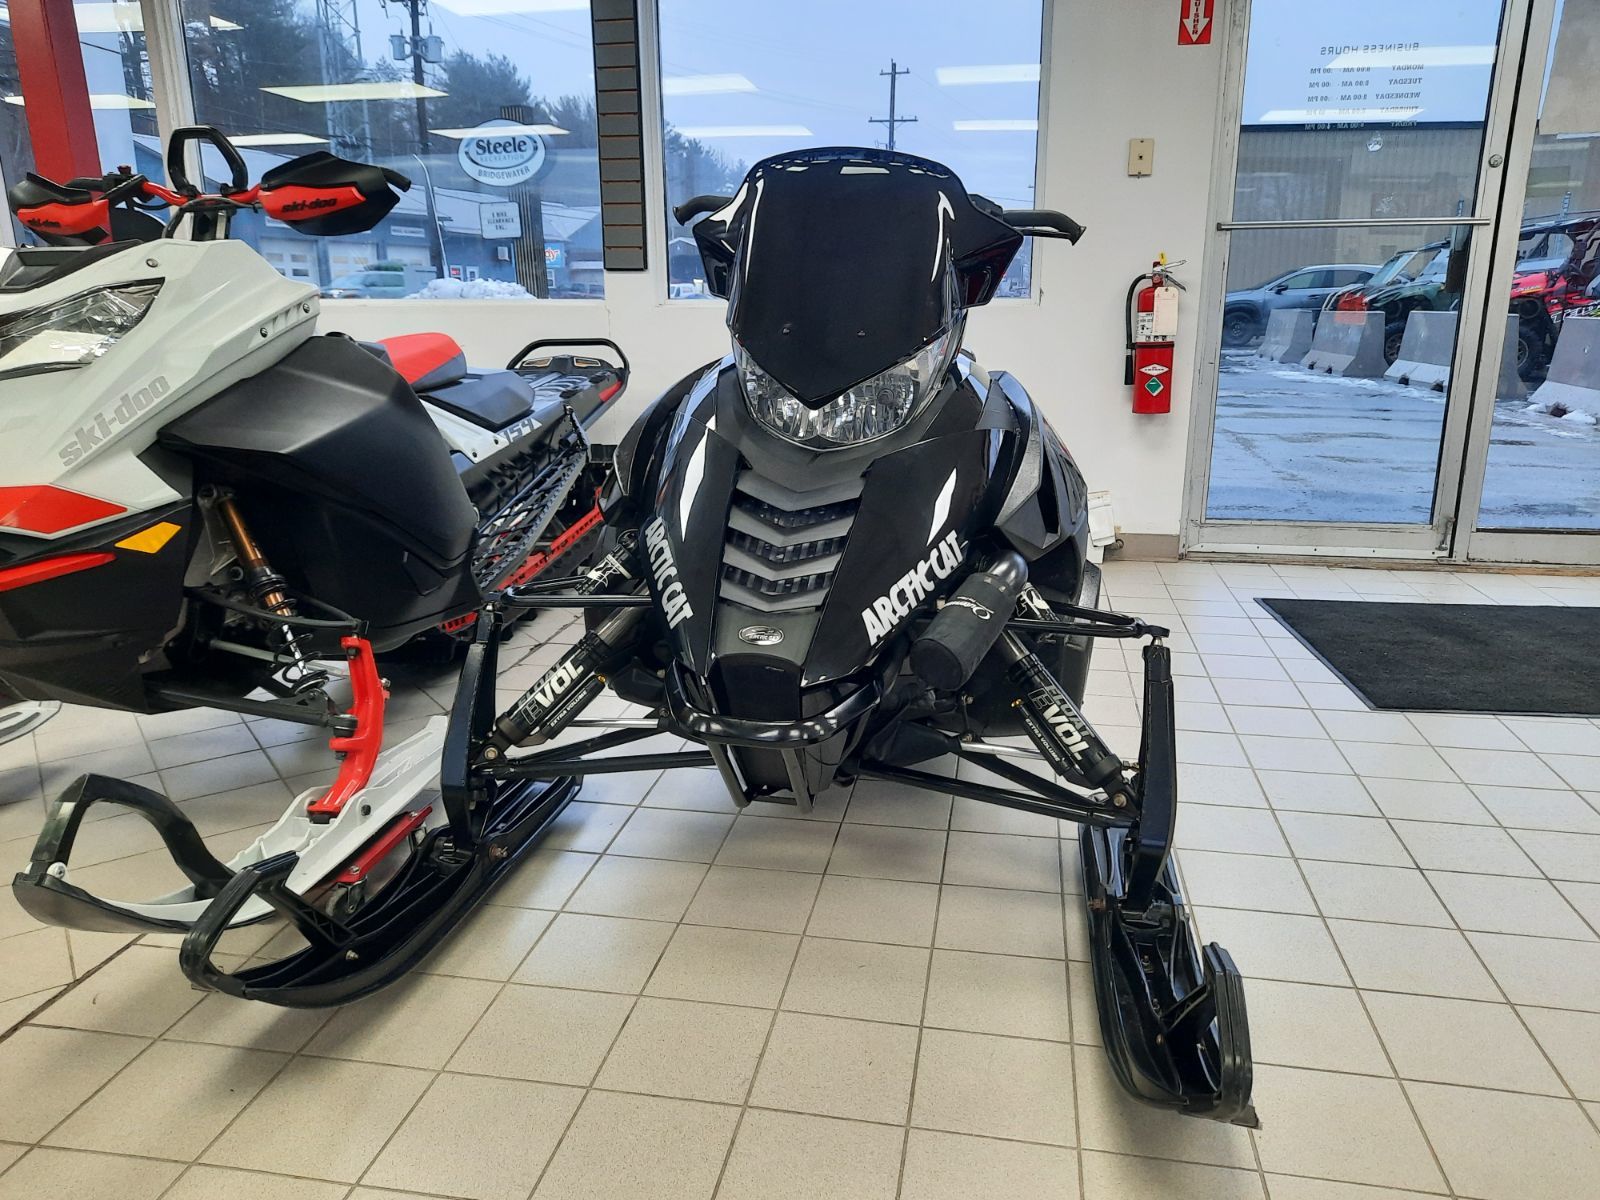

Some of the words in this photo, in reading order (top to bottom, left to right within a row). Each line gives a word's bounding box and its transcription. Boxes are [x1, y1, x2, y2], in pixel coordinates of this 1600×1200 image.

[1192, 0, 1200, 35] UISHER
[475, 136, 527, 156] Steele
[480, 154, 525, 162] RECREATION
[477, 165, 530, 180] BRIDGEWATER
[281, 198, 338, 213] ski-doo
[58, 375, 171, 467] ski-doo
[644, 516, 679, 592] ARCTIC
[661, 581, 694, 630] CAT
[861, 559, 936, 647] ARCTIC
[929, 529, 965, 580] CAT
[520, 658, 585, 726] EVOL
[550, 709, 568, 728] EXTRA
[565, 688, 588, 712] VOLUME
[1025, 718, 1042, 740] EXTRA
[1040, 736, 1061, 762] VOLUME
[1027, 687, 1090, 761] EVOL
